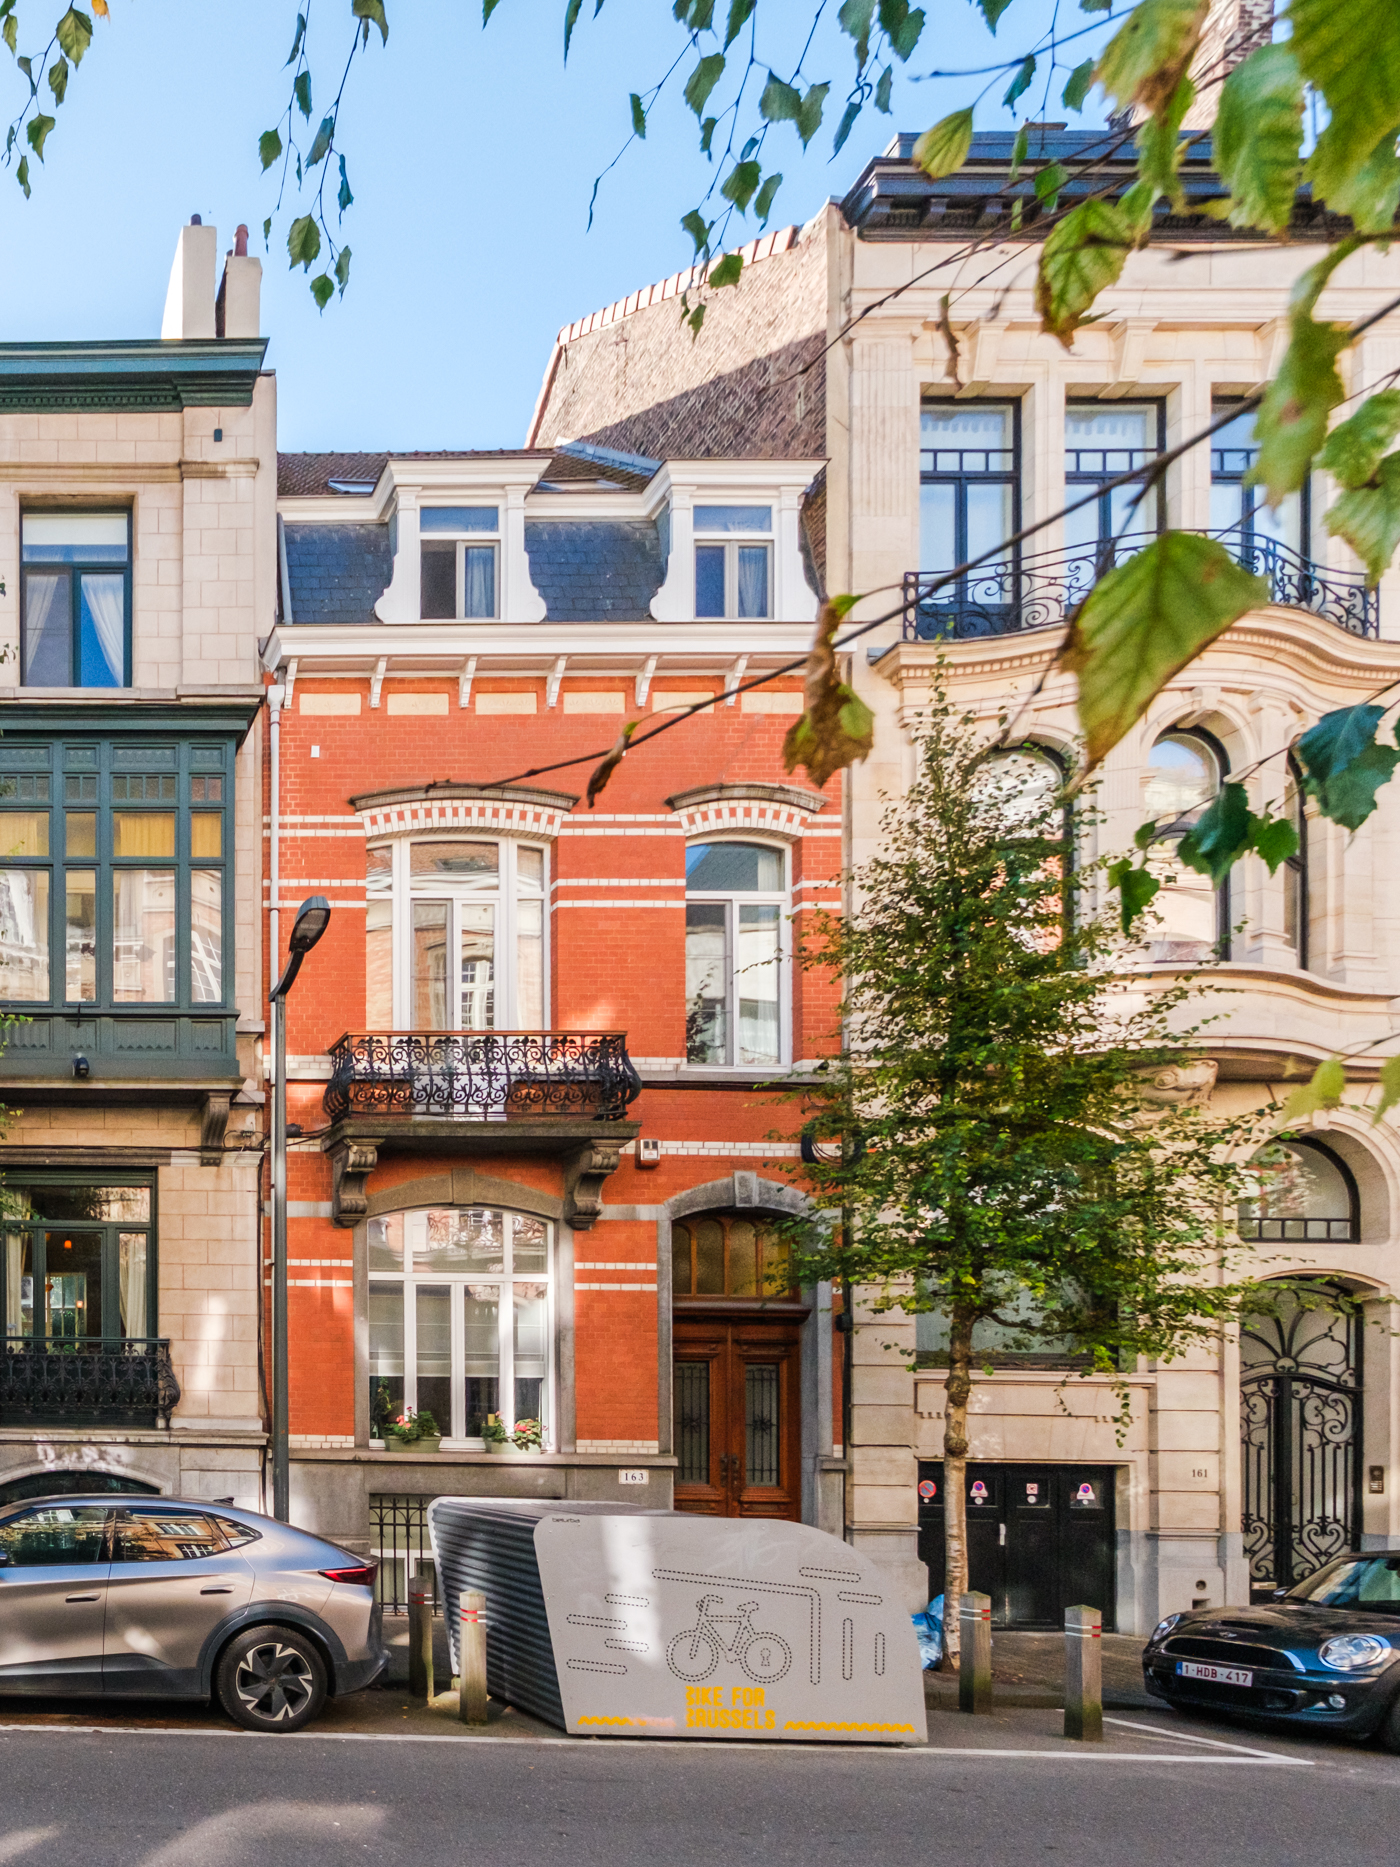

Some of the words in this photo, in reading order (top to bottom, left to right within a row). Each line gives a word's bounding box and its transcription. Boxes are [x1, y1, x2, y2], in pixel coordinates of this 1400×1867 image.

[625, 1472, 644, 1481] 163
[1192, 1468, 1208, 1478] 161
[1185, 1664, 1249, 1683] 1-HDB-417
[685, 1686, 724, 1707] BIKE
[731, 1687, 765, 1707] FOR
[685, 1708, 776, 1730] BRUSSELS
